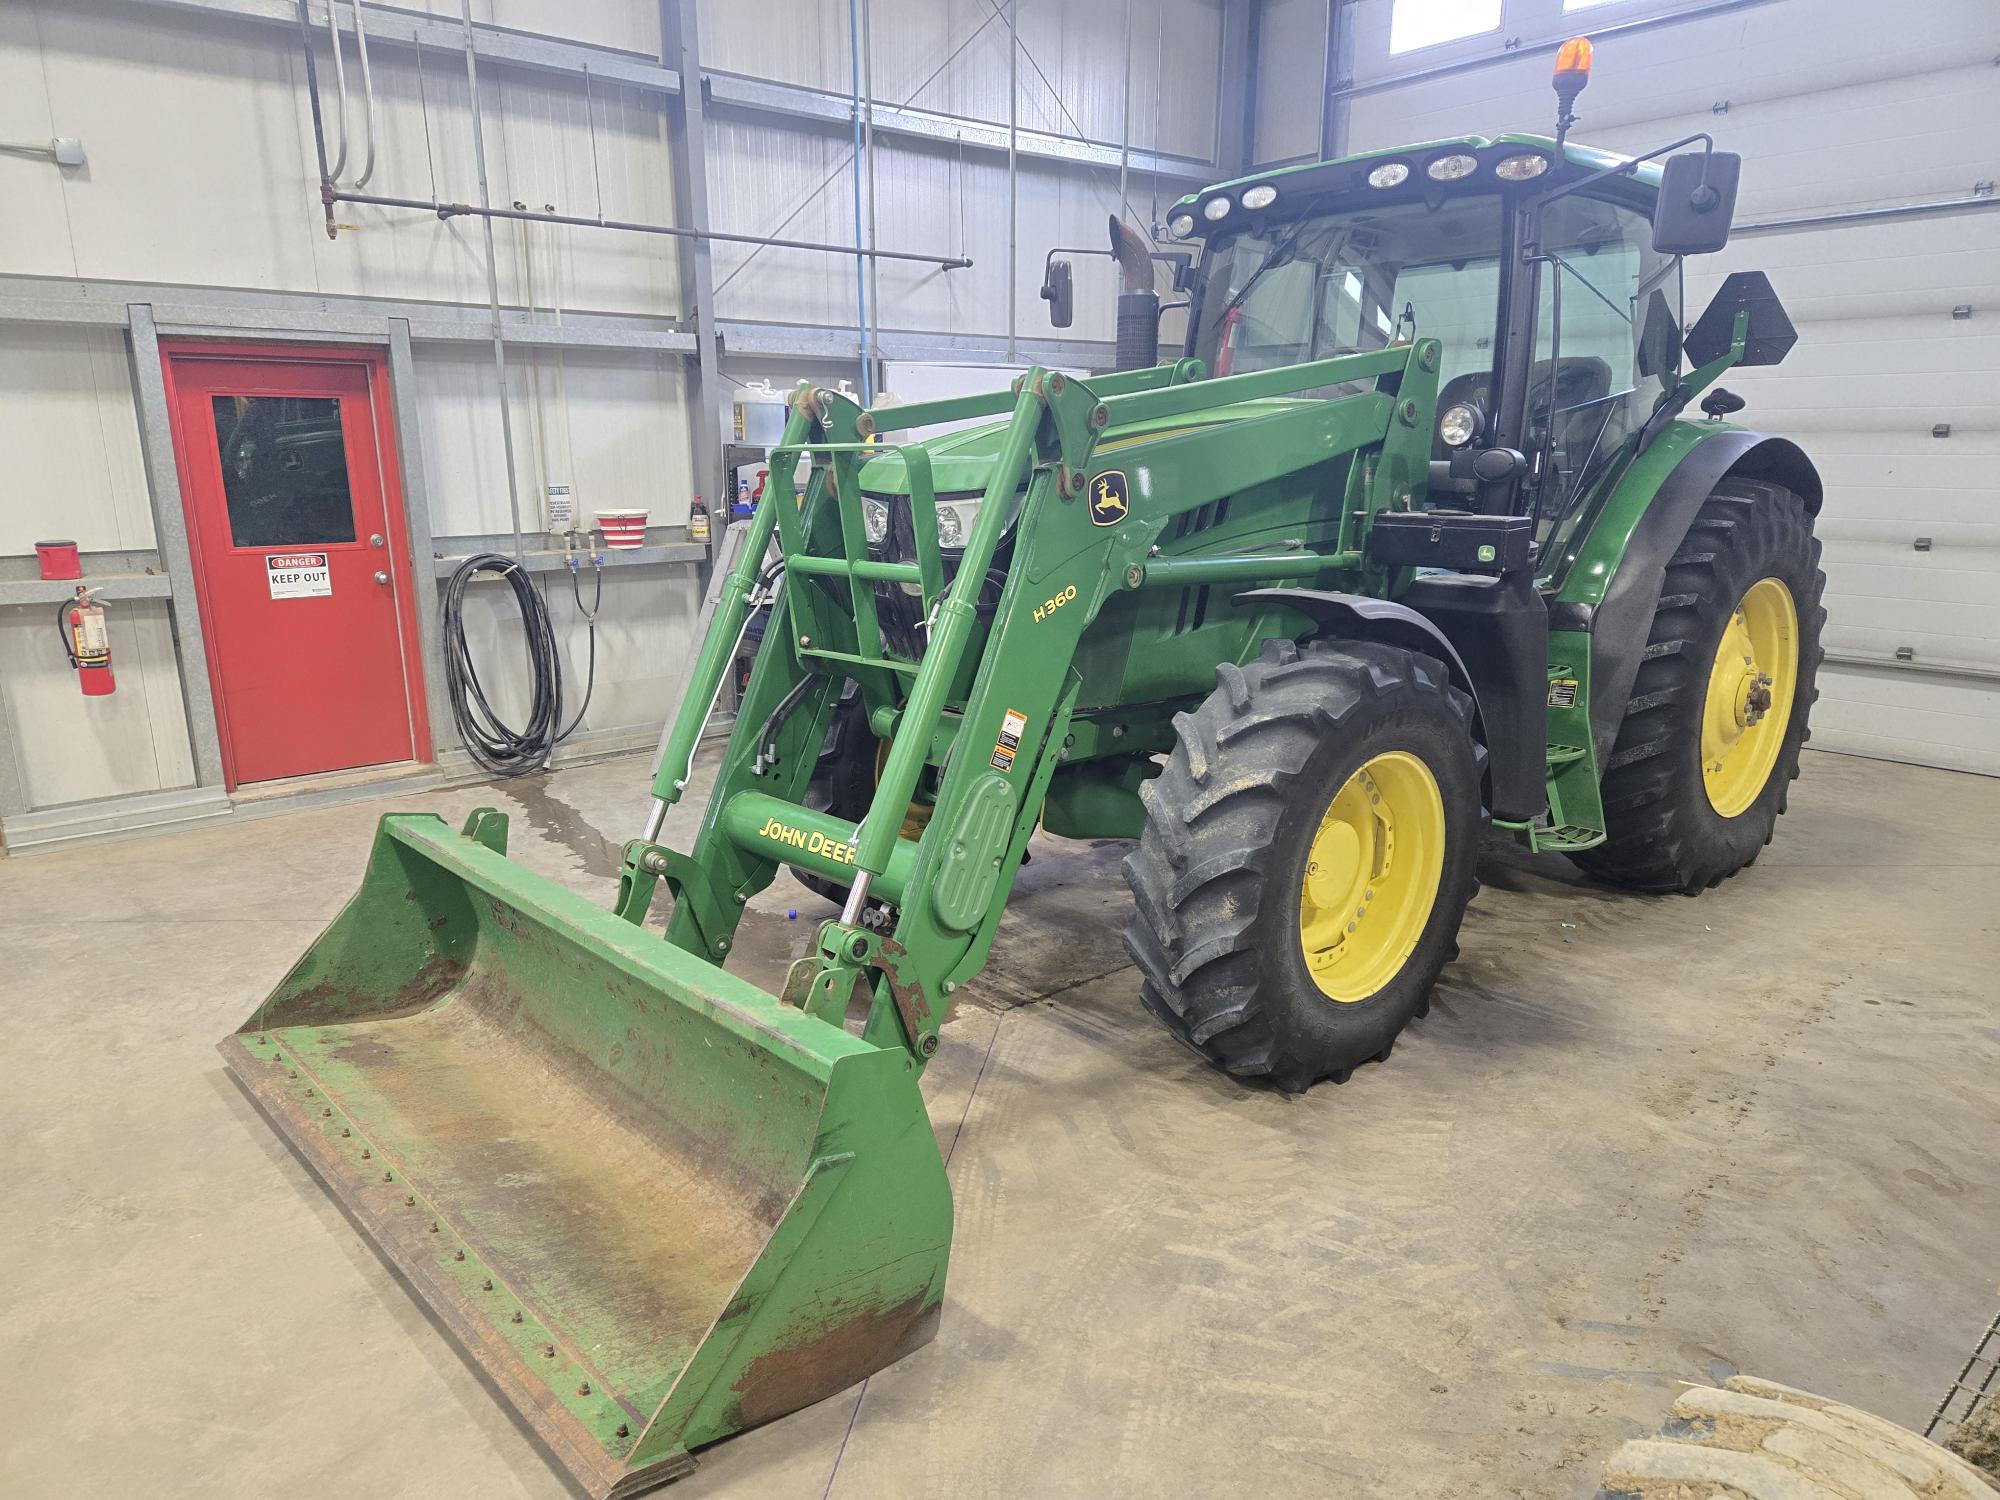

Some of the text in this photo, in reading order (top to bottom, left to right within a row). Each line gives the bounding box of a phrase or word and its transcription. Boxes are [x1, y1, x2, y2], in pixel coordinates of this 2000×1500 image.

[278, 557, 317, 567] DANGER
[271, 572, 326, 584] KEEP OUT
[1033, 585, 1077, 624] H360
[759, 817, 857, 865] JOHN DEER
